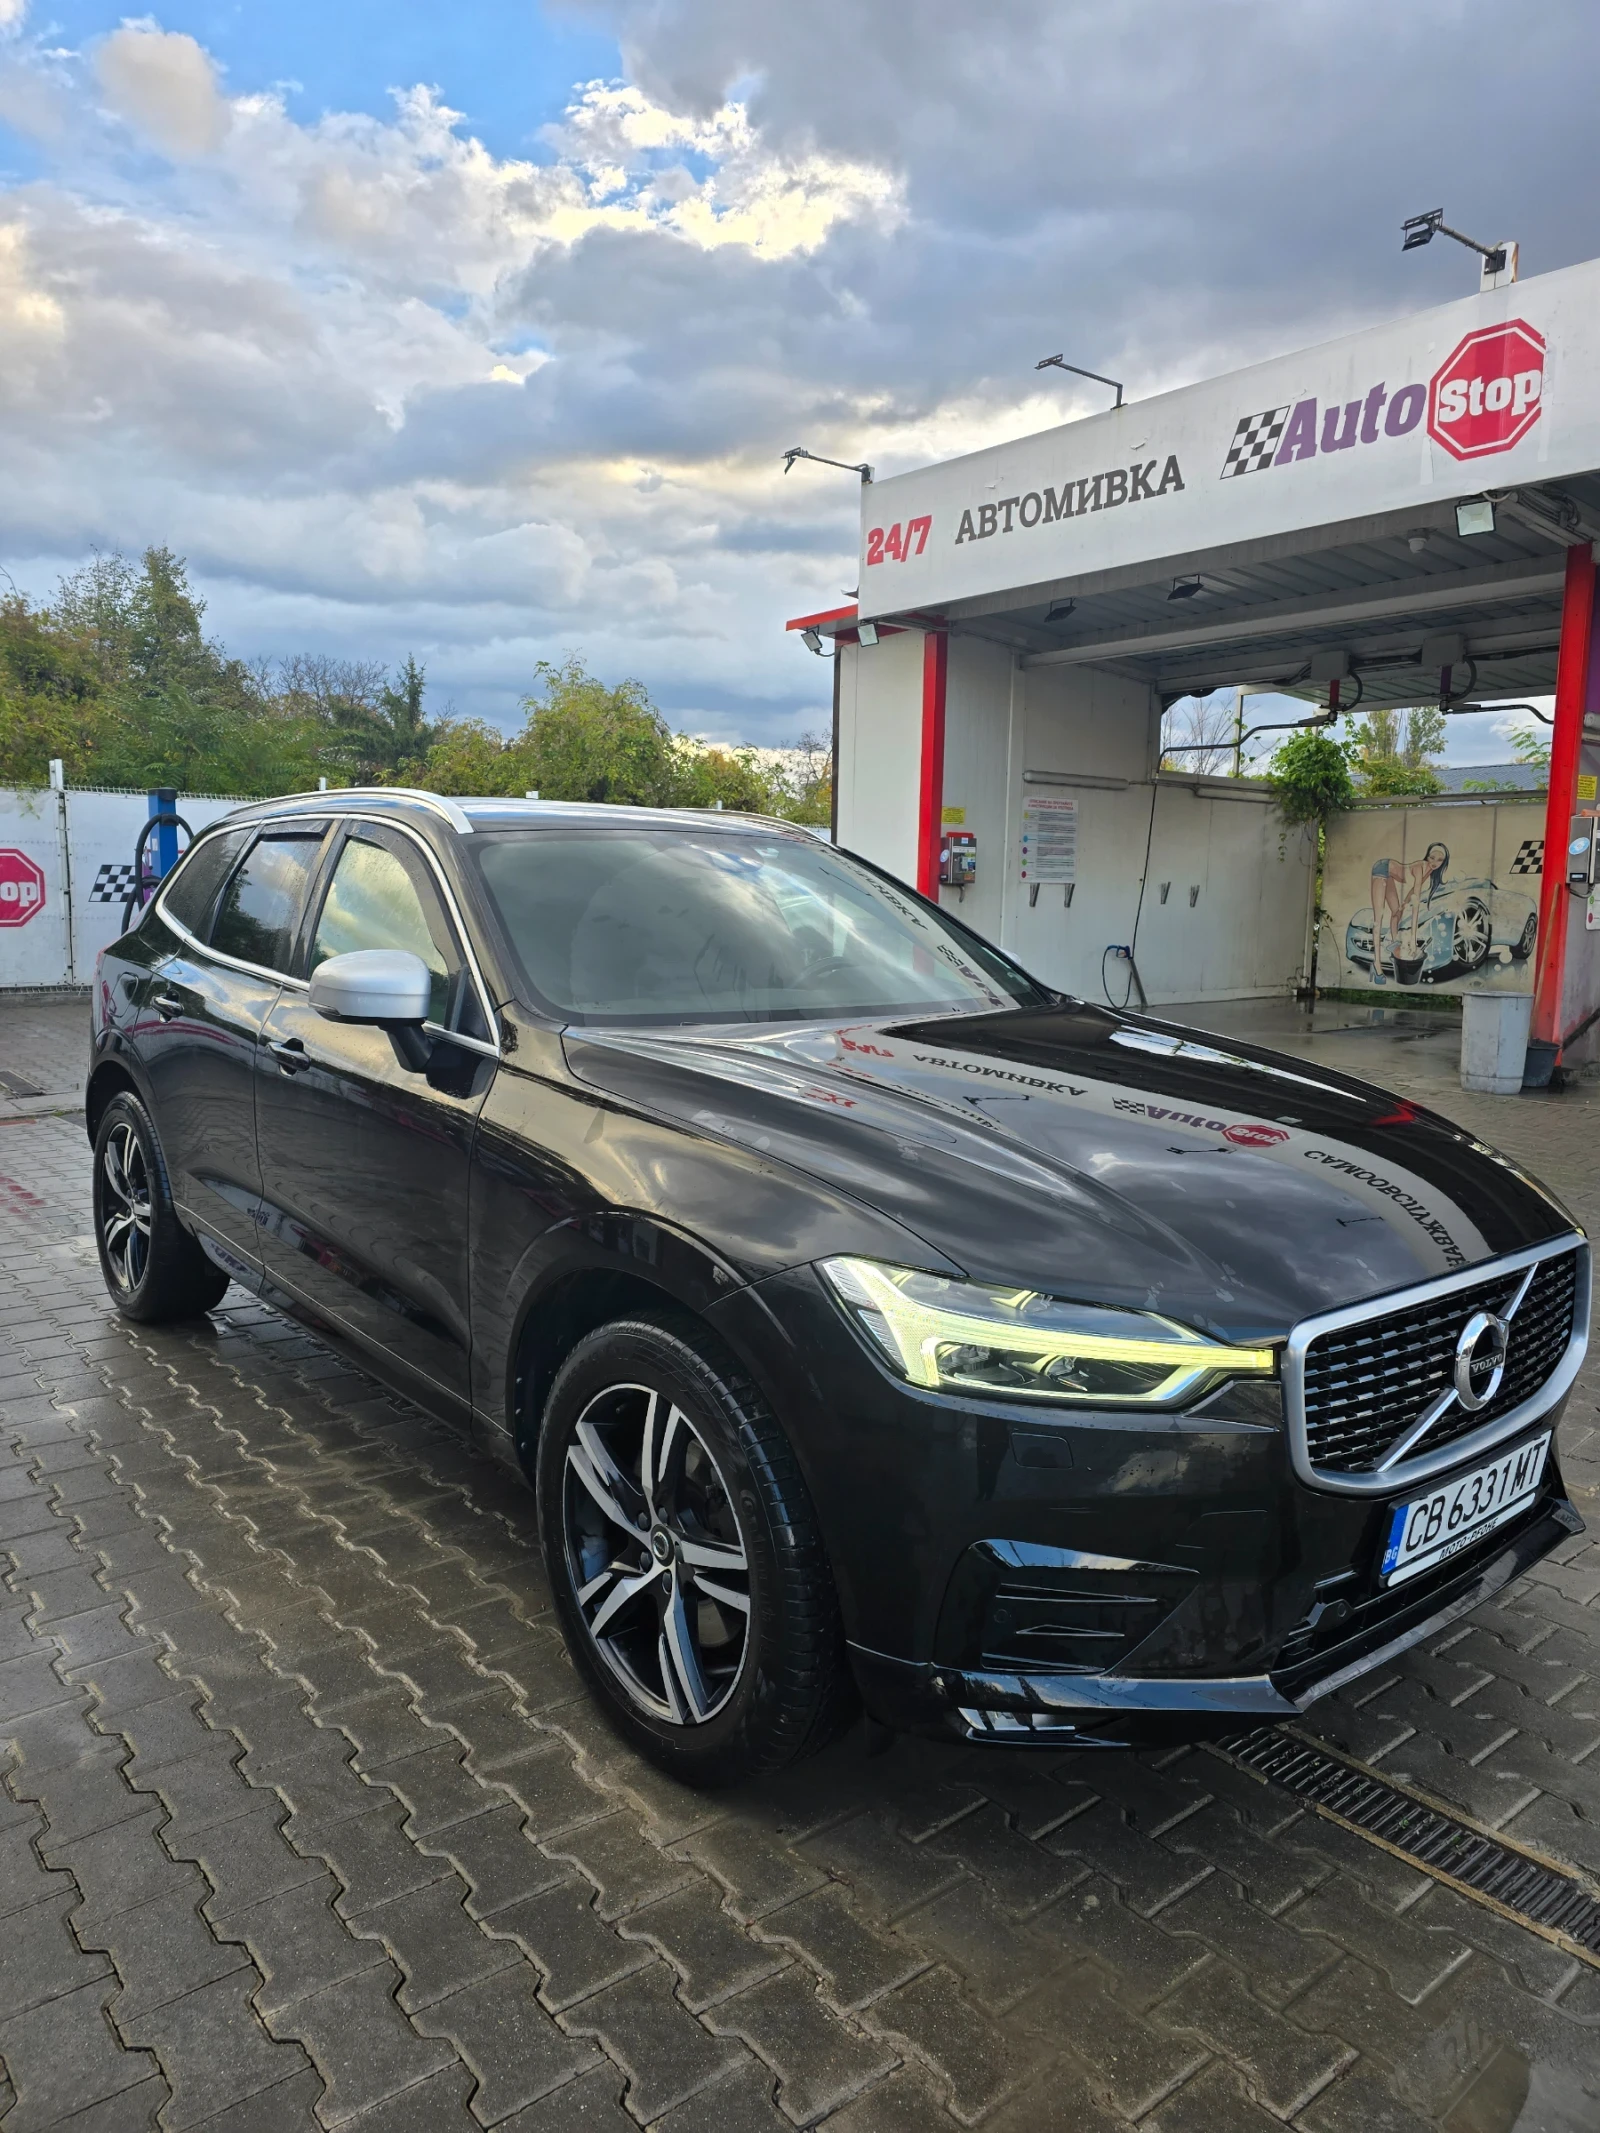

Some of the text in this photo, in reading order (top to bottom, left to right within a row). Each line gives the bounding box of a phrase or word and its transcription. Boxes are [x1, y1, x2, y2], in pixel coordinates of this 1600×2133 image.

[1274, 369, 1542, 466] Auto Stop
[867, 454, 1185, 566] 24/7 АВТОМИВКА
[0, 881, 37, 907] op
[1471, 1353, 1502, 1373] VOLVO
[1384, 1546, 1398, 1565] BG
